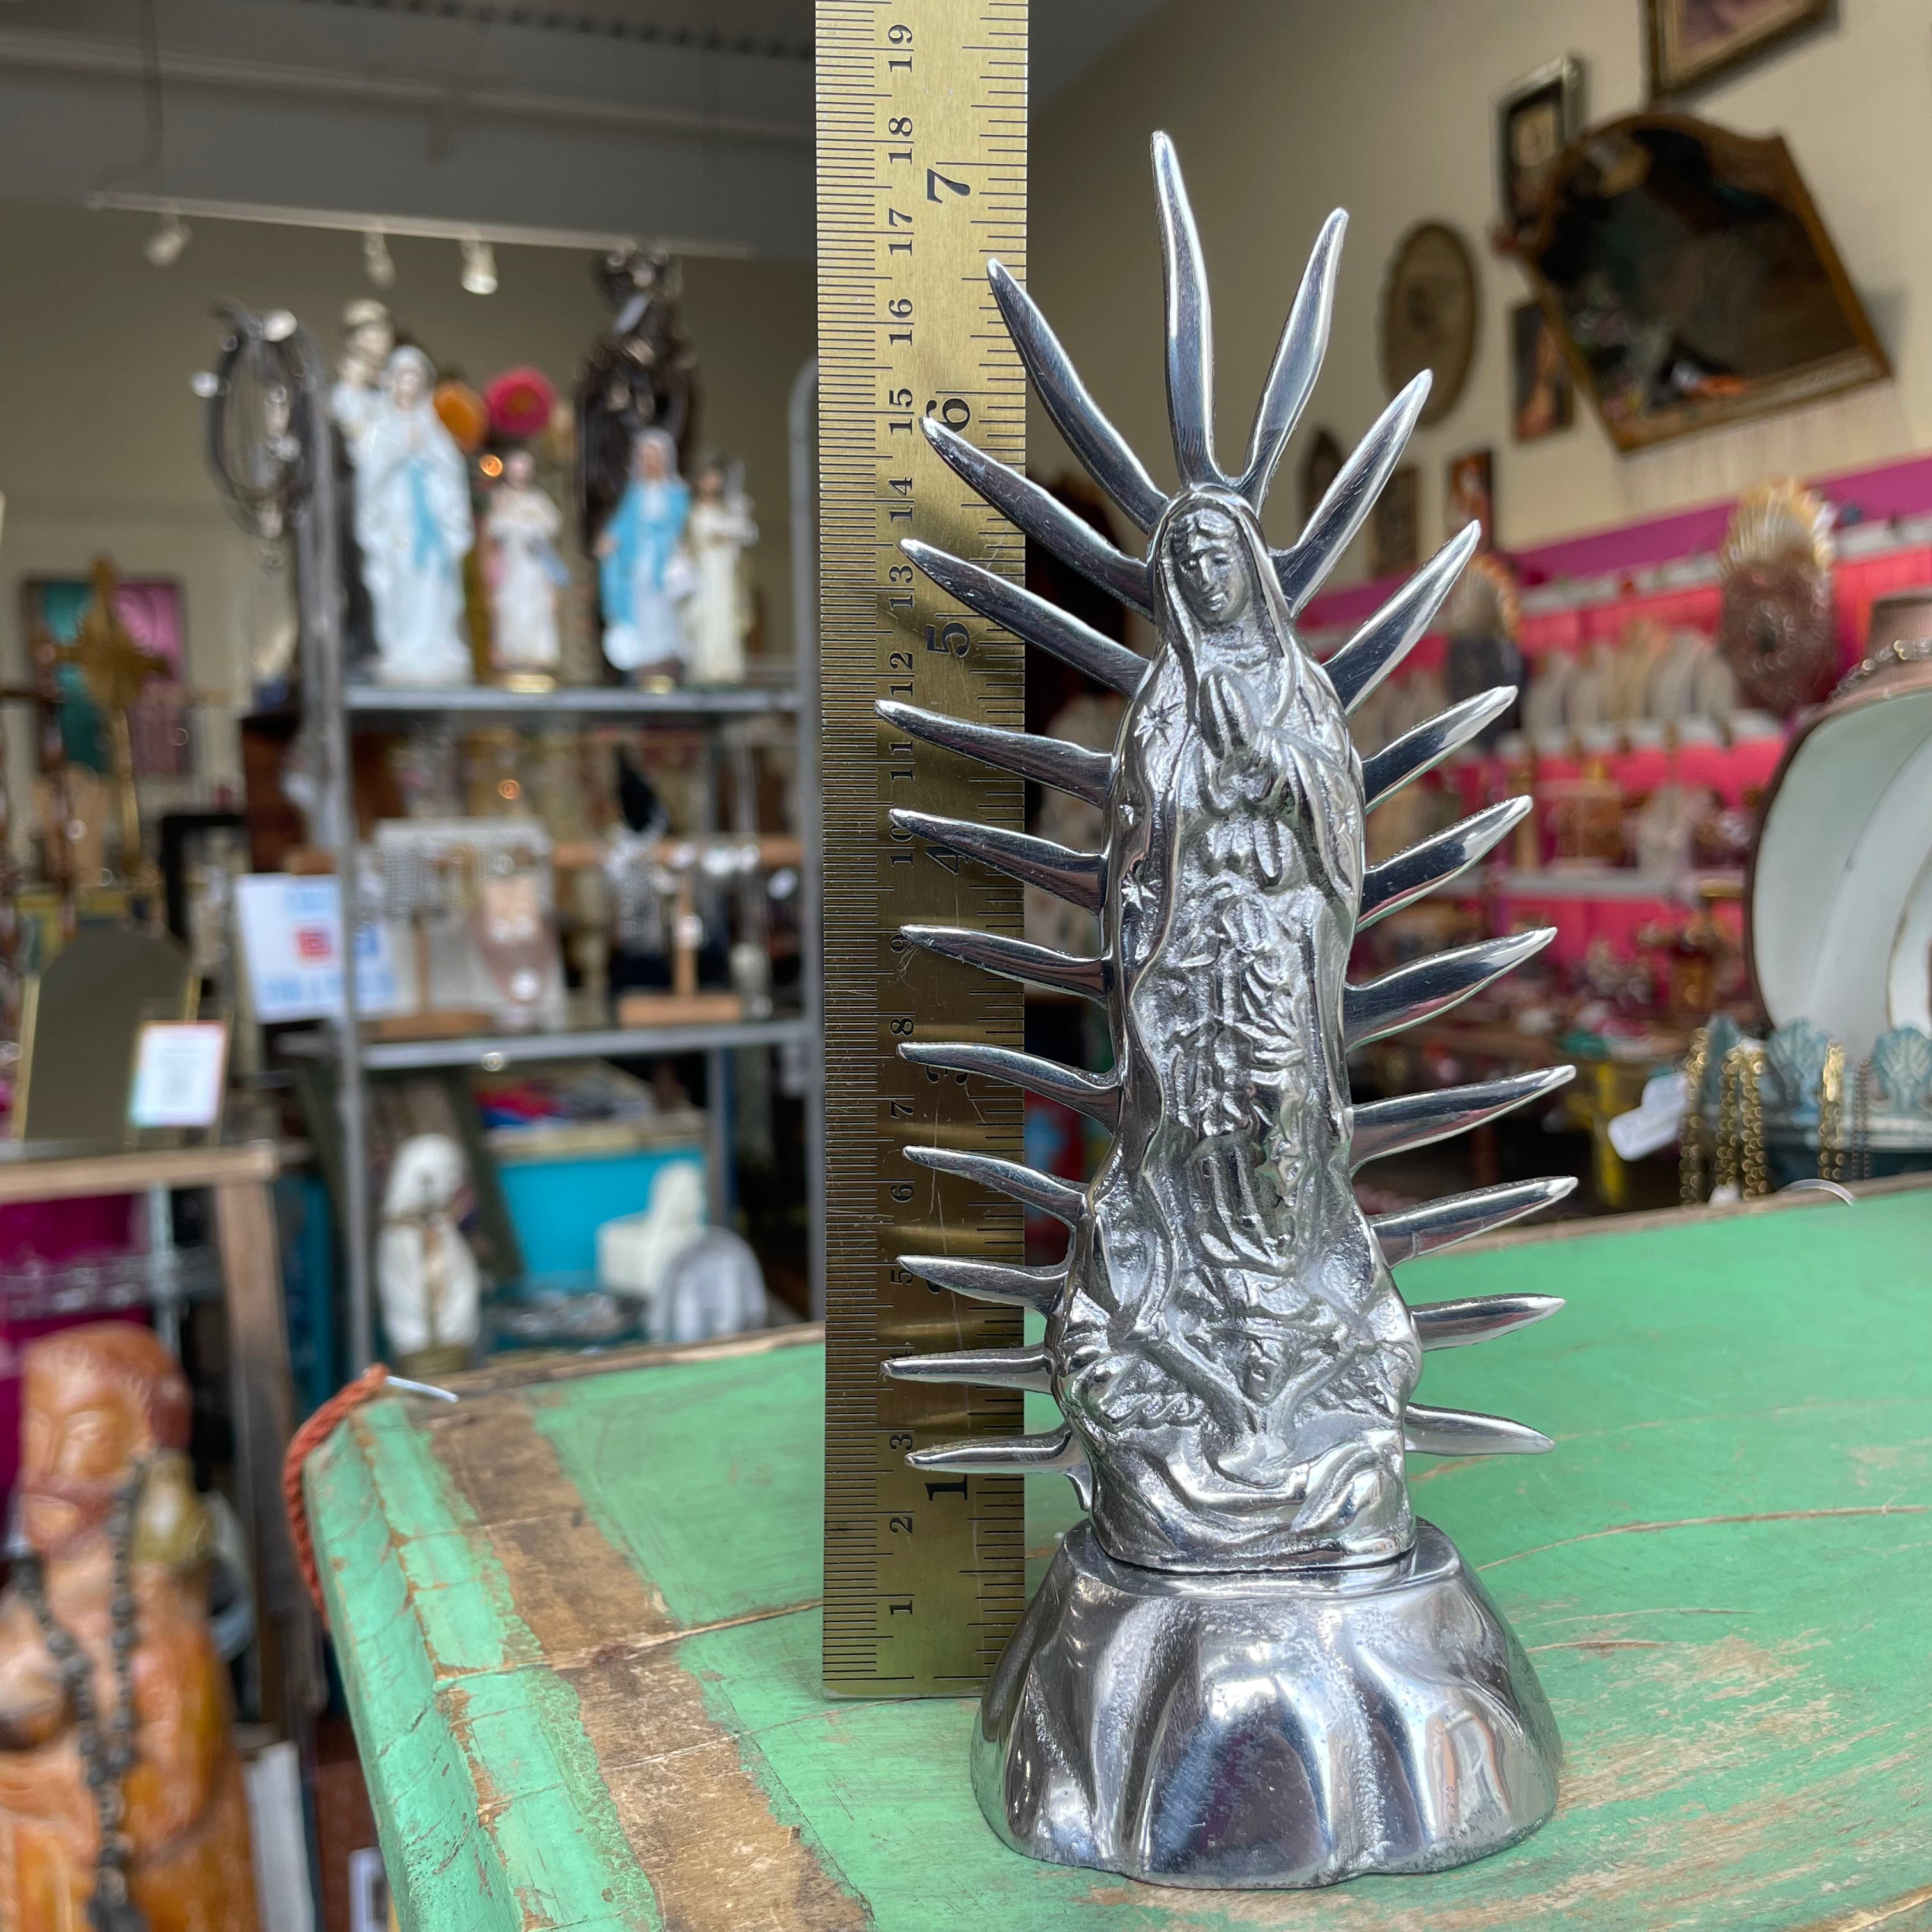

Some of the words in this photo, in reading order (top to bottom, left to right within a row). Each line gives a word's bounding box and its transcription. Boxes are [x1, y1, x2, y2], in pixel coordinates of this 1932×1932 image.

[888, 24, 913, 73] 19
[888, 117, 913, 165] 18
[927, 168, 970, 204] 7
[889, 208, 913, 256] 17
[889, 298, 914, 346] 16
[889, 388, 914, 435] 15
[888, 477, 914, 523] 14
[889, 565, 914, 611] 13
[926, 622, 970, 658] 5
[889, 651, 914, 697] 12
[889, 739, 914, 783] 11
[890, 1017, 914, 1036] 8
[890, 1101, 914, 1119] 7
[890, 1184, 914, 1203] 6
[890, 1434, 914, 1452] 3
[925, 1474, 968, 1501] 1
[890, 1517, 913, 1535] 2
[890, 1600, 913, 1615] 1
